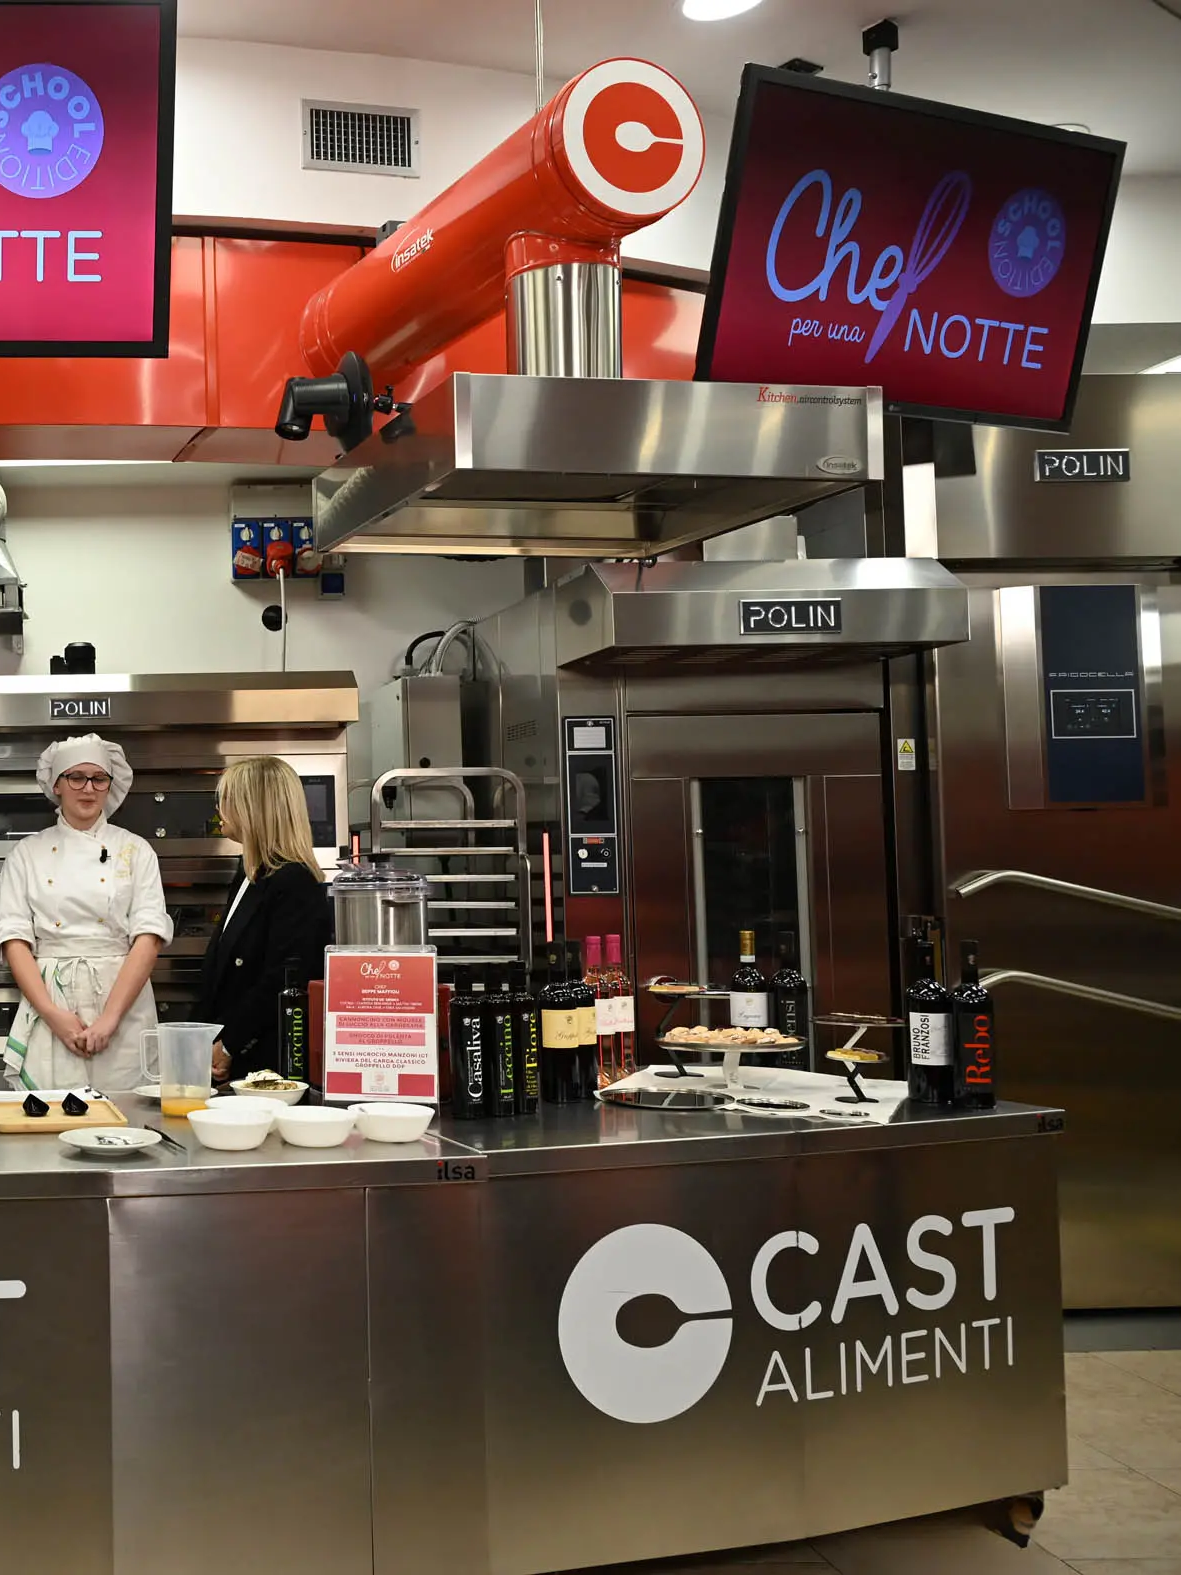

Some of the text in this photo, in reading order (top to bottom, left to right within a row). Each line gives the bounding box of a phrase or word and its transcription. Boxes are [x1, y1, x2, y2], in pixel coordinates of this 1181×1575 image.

[394, 227, 434, 269] insatek
[766, 169, 972, 364] Chef
[788, 308, 1050, 370] per una NOTTE
[1044, 454, 1123, 476] POLIN
[748, 604, 835, 629] POLIN
[53, 700, 107, 716] POLIN
[288, 1007, 304, 1080] Leccino
[466, 1017, 483, 1098] Casaliva
[500, 1015, 514, 1094] Leccino
[525, 1012, 538, 1068] Fiore
[912, 1027, 921, 1060] BRUNO
[920, 1014, 931, 1060] FRANZOSI
[963, 1015, 992, 1084] Rebo
[436, 1160, 475, 1181] ilsa
[750, 1206, 1015, 1331] CAST
[756, 1316, 1014, 1407] ALIMENTI
